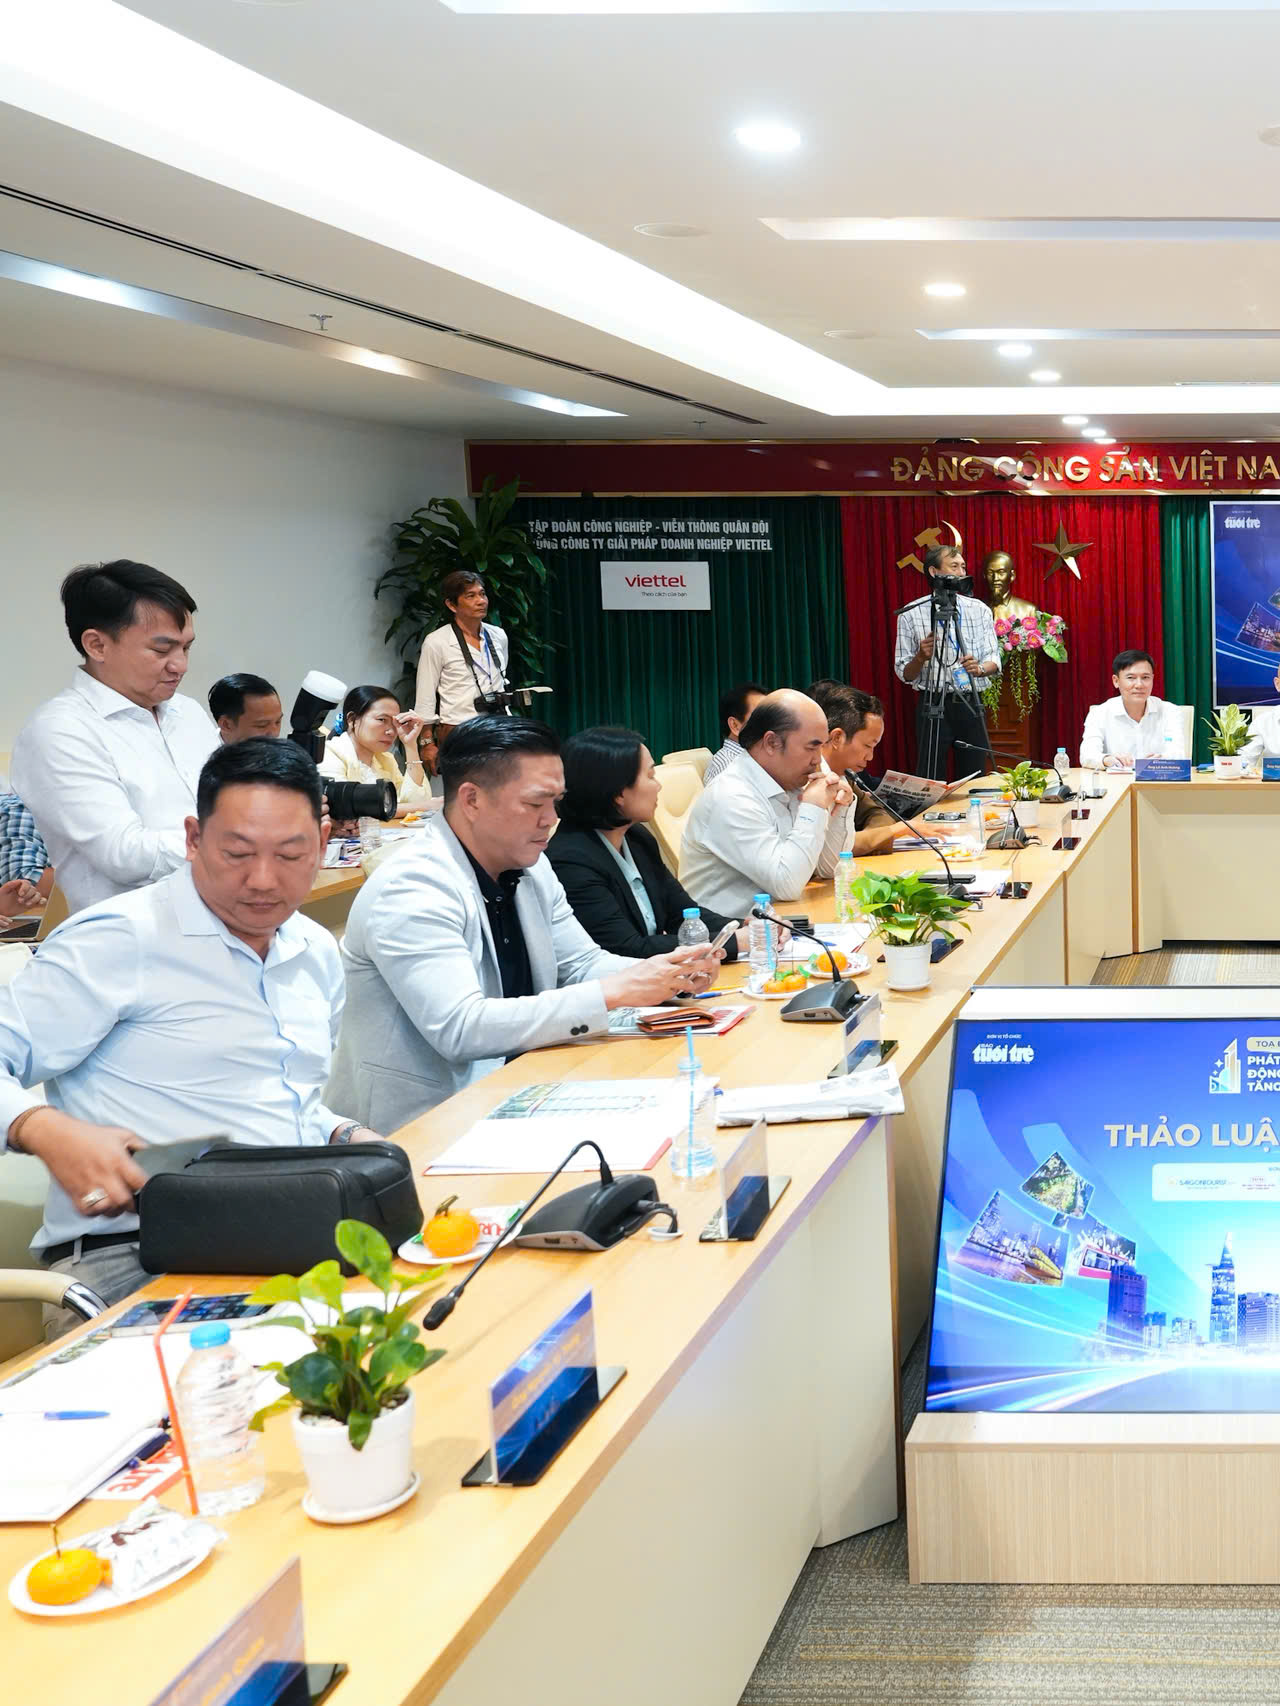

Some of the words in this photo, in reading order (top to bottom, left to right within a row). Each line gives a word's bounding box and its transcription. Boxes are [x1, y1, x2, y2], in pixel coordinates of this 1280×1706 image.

[890, 446, 984, 481] ĐẢNG
[993, 450, 1091, 487] CỘNG
[1098, 445, 1163, 482] SẢN
[1168, 449, 1228, 487] VIỆT
[529, 520, 549, 534] TẬP
[551, 520, 580, 532] ĐOÀN
[583, 519, 612, 532] CÔNG
[615, 519, 652, 535] NGHIỆP
[662, 518, 685, 533] VIỄN
[687, 519, 720, 533] THÔNG
[722, 519, 750, 534] QUÂN
[752, 520, 769, 536] ĐỘI
[533, 532, 558, 549] ỔNG
[560, 536, 590, 550] CÔNG
[592, 538, 605, 550] TY
[606, 534, 628, 550] GIẢI
[630, 535, 659, 550] PHÁP
[661, 538, 695, 550] DOANH
[697, 537, 733, 552] NGHIỆP
[735, 538, 773, 551] VIETTEL
[625, 574, 686, 587] viettel
[972, 1044, 1008, 1062] tuổi
[1008, 1043, 1034, 1062] trẻ
[1255, 1040, 1275, 1049] TOẠ
[1247, 1053, 1280, 1065] PHÁT
[1104, 1116, 1201, 1147] THẢO
